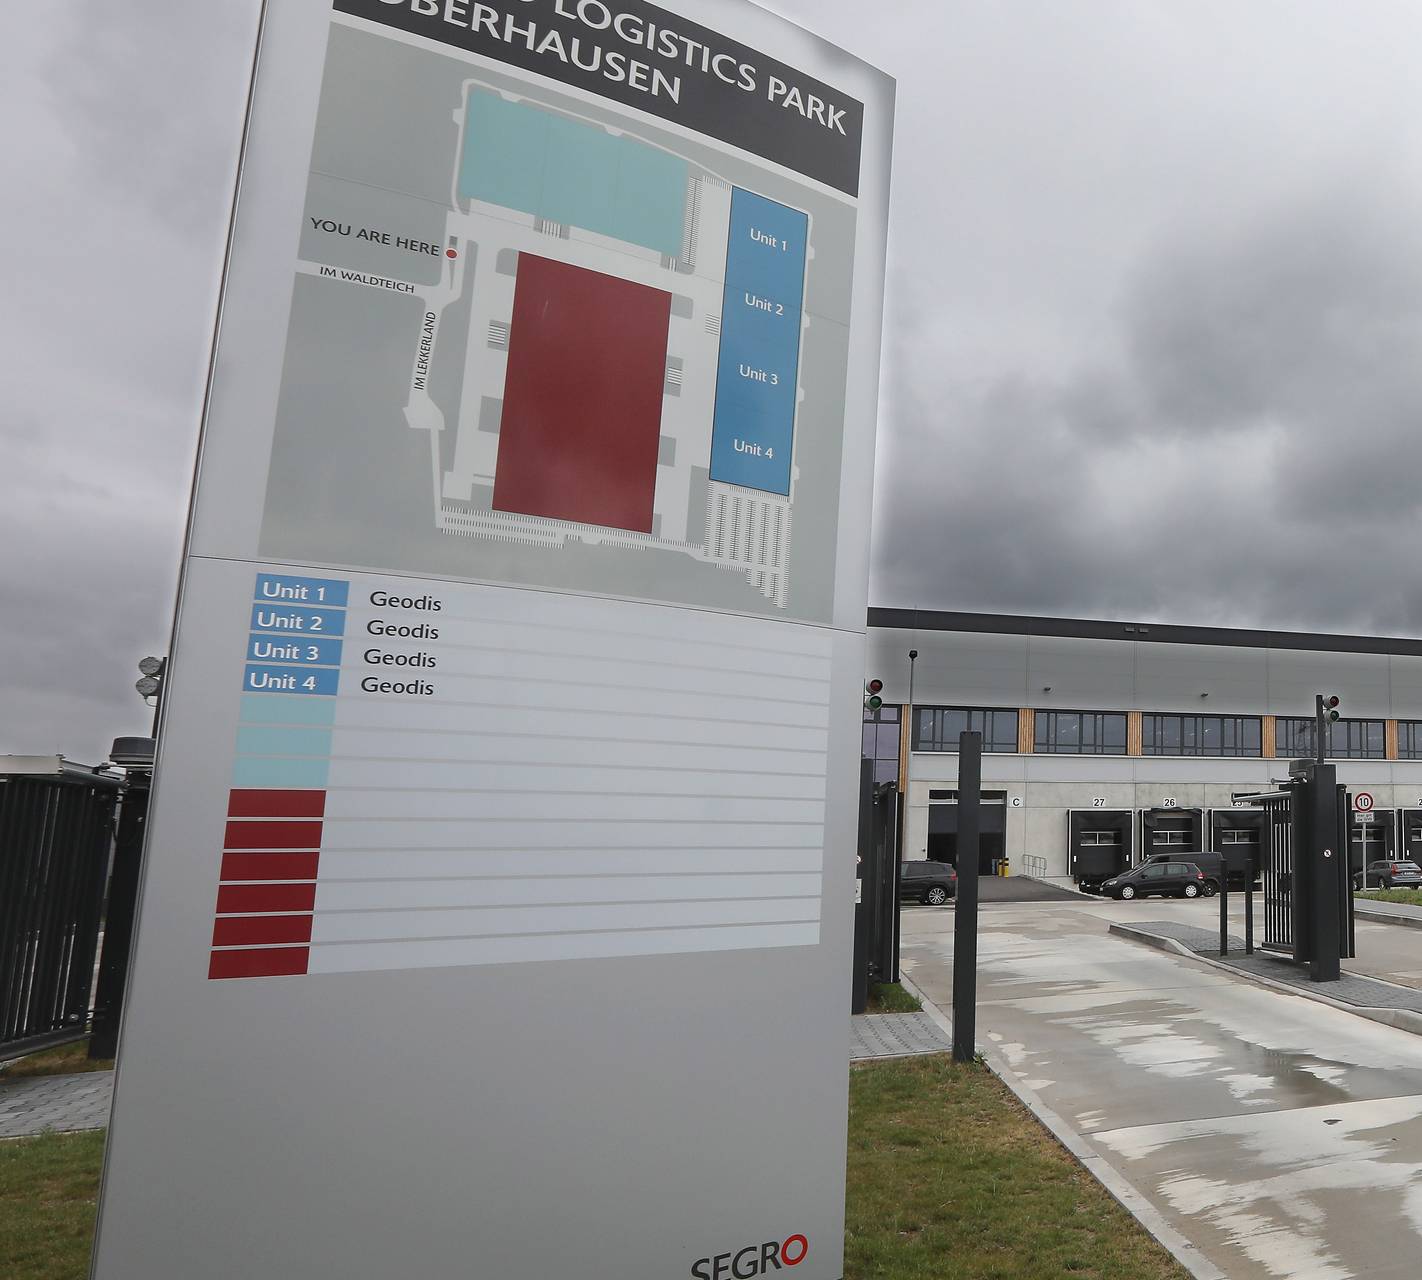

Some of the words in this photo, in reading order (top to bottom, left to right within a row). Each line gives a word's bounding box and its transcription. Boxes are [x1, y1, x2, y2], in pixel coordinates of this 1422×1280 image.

[555, 0, 756, 92] LOGISTICS
[767, 75, 847, 136] PARK
[310, 217, 351, 236] YOU
[356, 228, 391, 245] ARE
[396, 237, 440, 257] HERE
[750, 228, 777, 248] Unit
[781, 240, 788, 251] 1
[319, 266, 336, 277] IM
[341, 270, 415, 294] WALDTEICH
[745, 292, 772, 313] Unit
[775, 304, 784, 316] 2
[416, 311, 437, 375] LEKKERLAND
[413, 378, 426, 391] IM
[739, 364, 767, 382] Unit
[770, 373, 779, 385] 3
[733, 439, 762, 457] Unit
[764, 447, 774, 460] 4
[262, 581, 308, 600] Unit
[317, 587, 326, 601] 1
[369, 590, 442, 612] Geodis
[257, 611, 304, 630] Unit
[309, 616, 323, 631] 2
[366, 619, 440, 640] Geodis
[253, 641, 300, 660] Unit
[305, 646, 319, 661] 3
[363, 648, 437, 668] Geodis
[249, 672, 297, 690] Unit
[301, 675, 316, 691] 4
[360, 676, 435, 696] Geodis
[1013, 798, 1020, 806] C
[1093, 798, 1105, 807] 27
[1164, 798, 1175, 807] 26
[1359, 797, 1369, 807] 10
[690, 1233, 809, 1280] SEGRO
